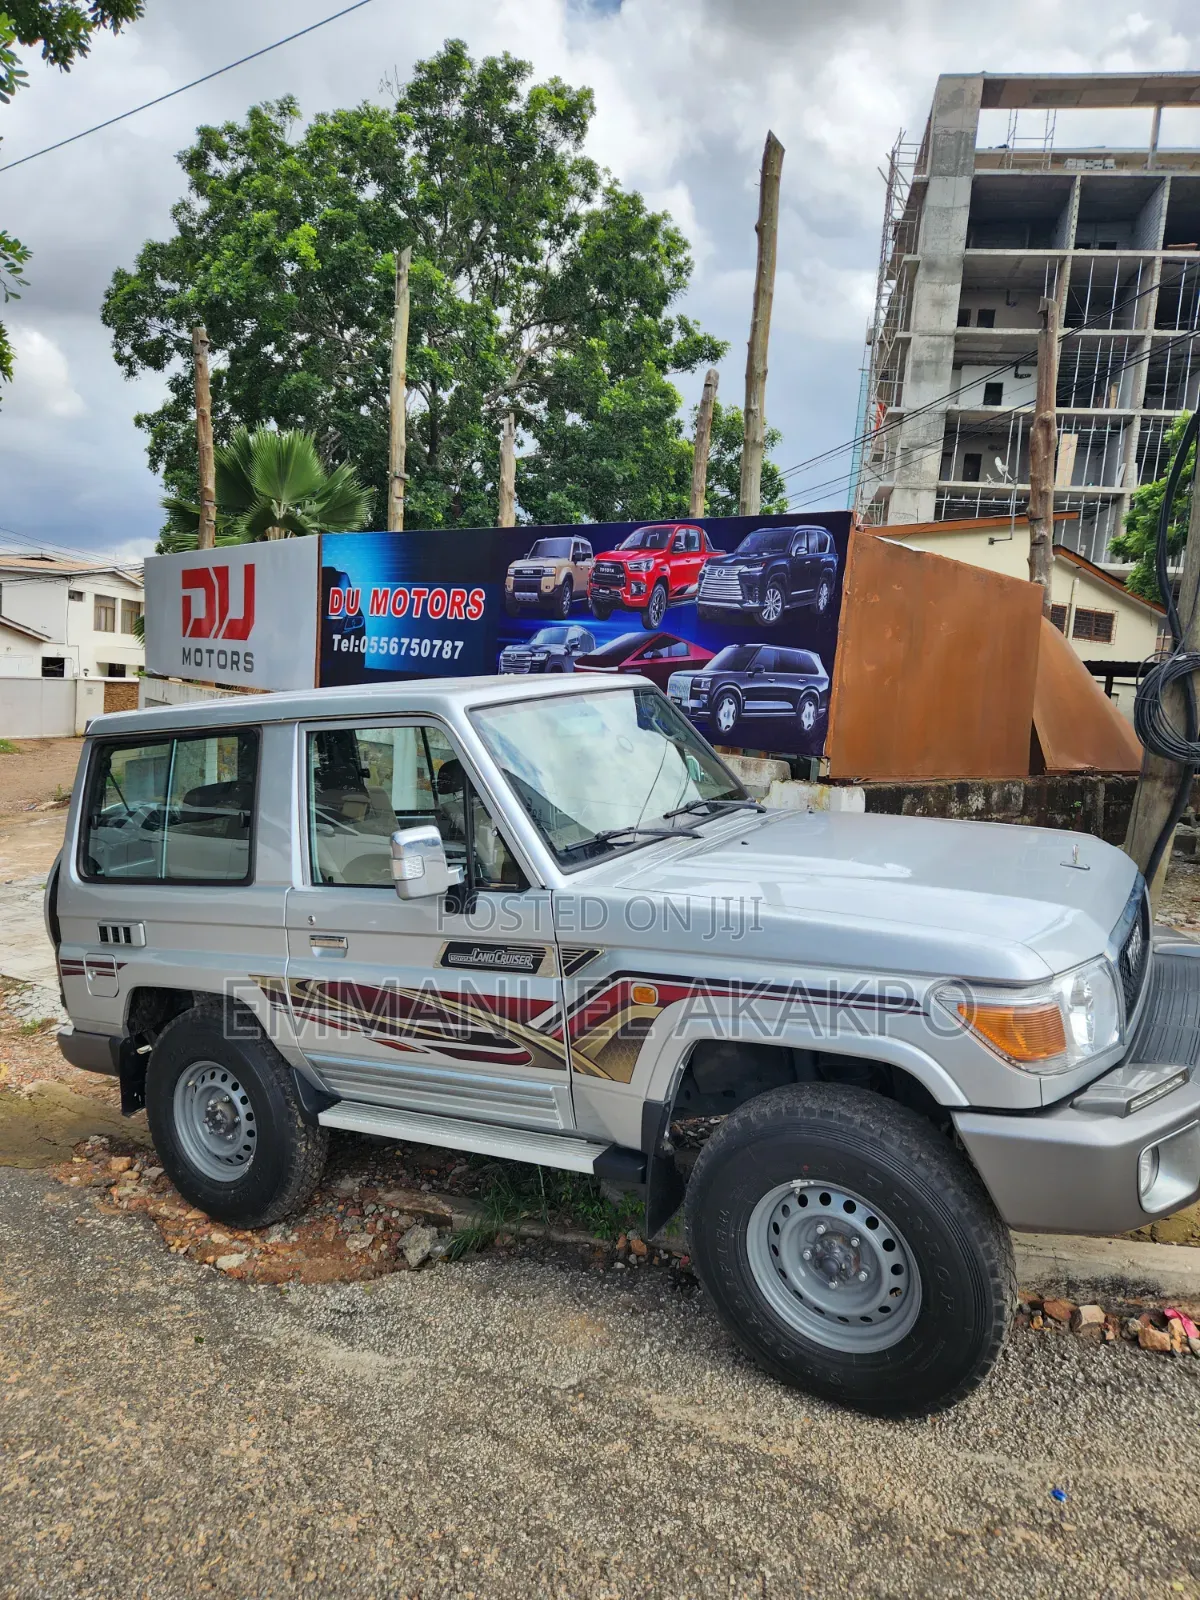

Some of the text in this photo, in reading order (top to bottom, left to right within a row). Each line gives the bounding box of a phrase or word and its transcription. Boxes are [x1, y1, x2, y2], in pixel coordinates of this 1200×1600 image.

[329, 587, 486, 621] DU MOTORS
[182, 647, 255, 673] MOTORS
[332, 634, 464, 660] Tel:0556750787
